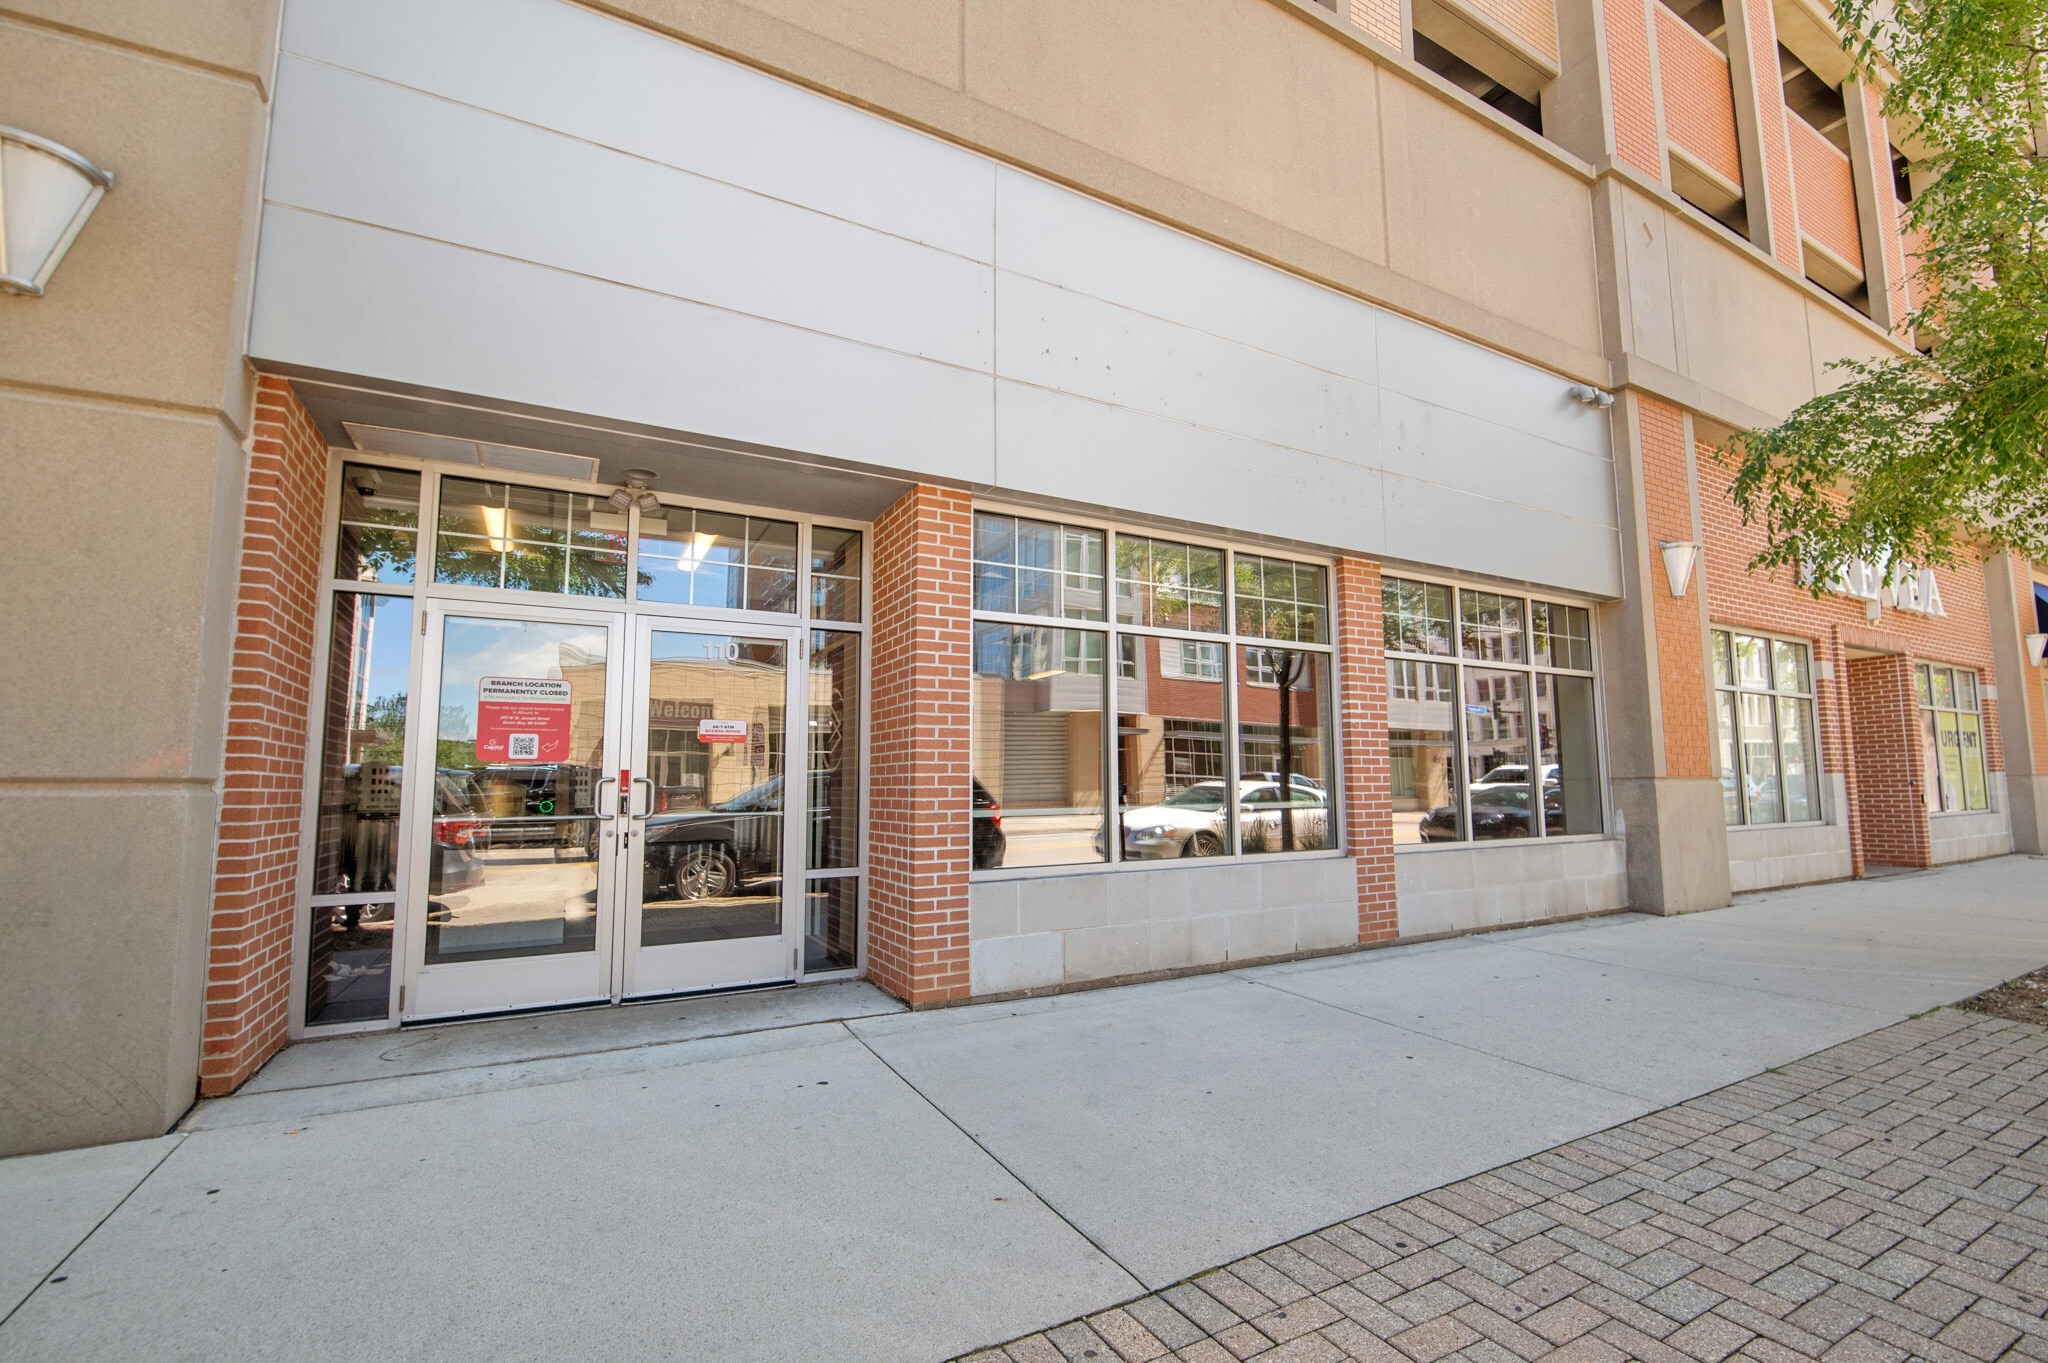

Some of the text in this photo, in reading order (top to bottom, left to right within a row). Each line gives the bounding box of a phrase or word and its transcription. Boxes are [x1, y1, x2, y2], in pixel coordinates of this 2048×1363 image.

[703, 640, 739, 661] 110
[483, 687, 538, 695] PERMANENTLY
[1941, 730, 1977, 748] URGENT
